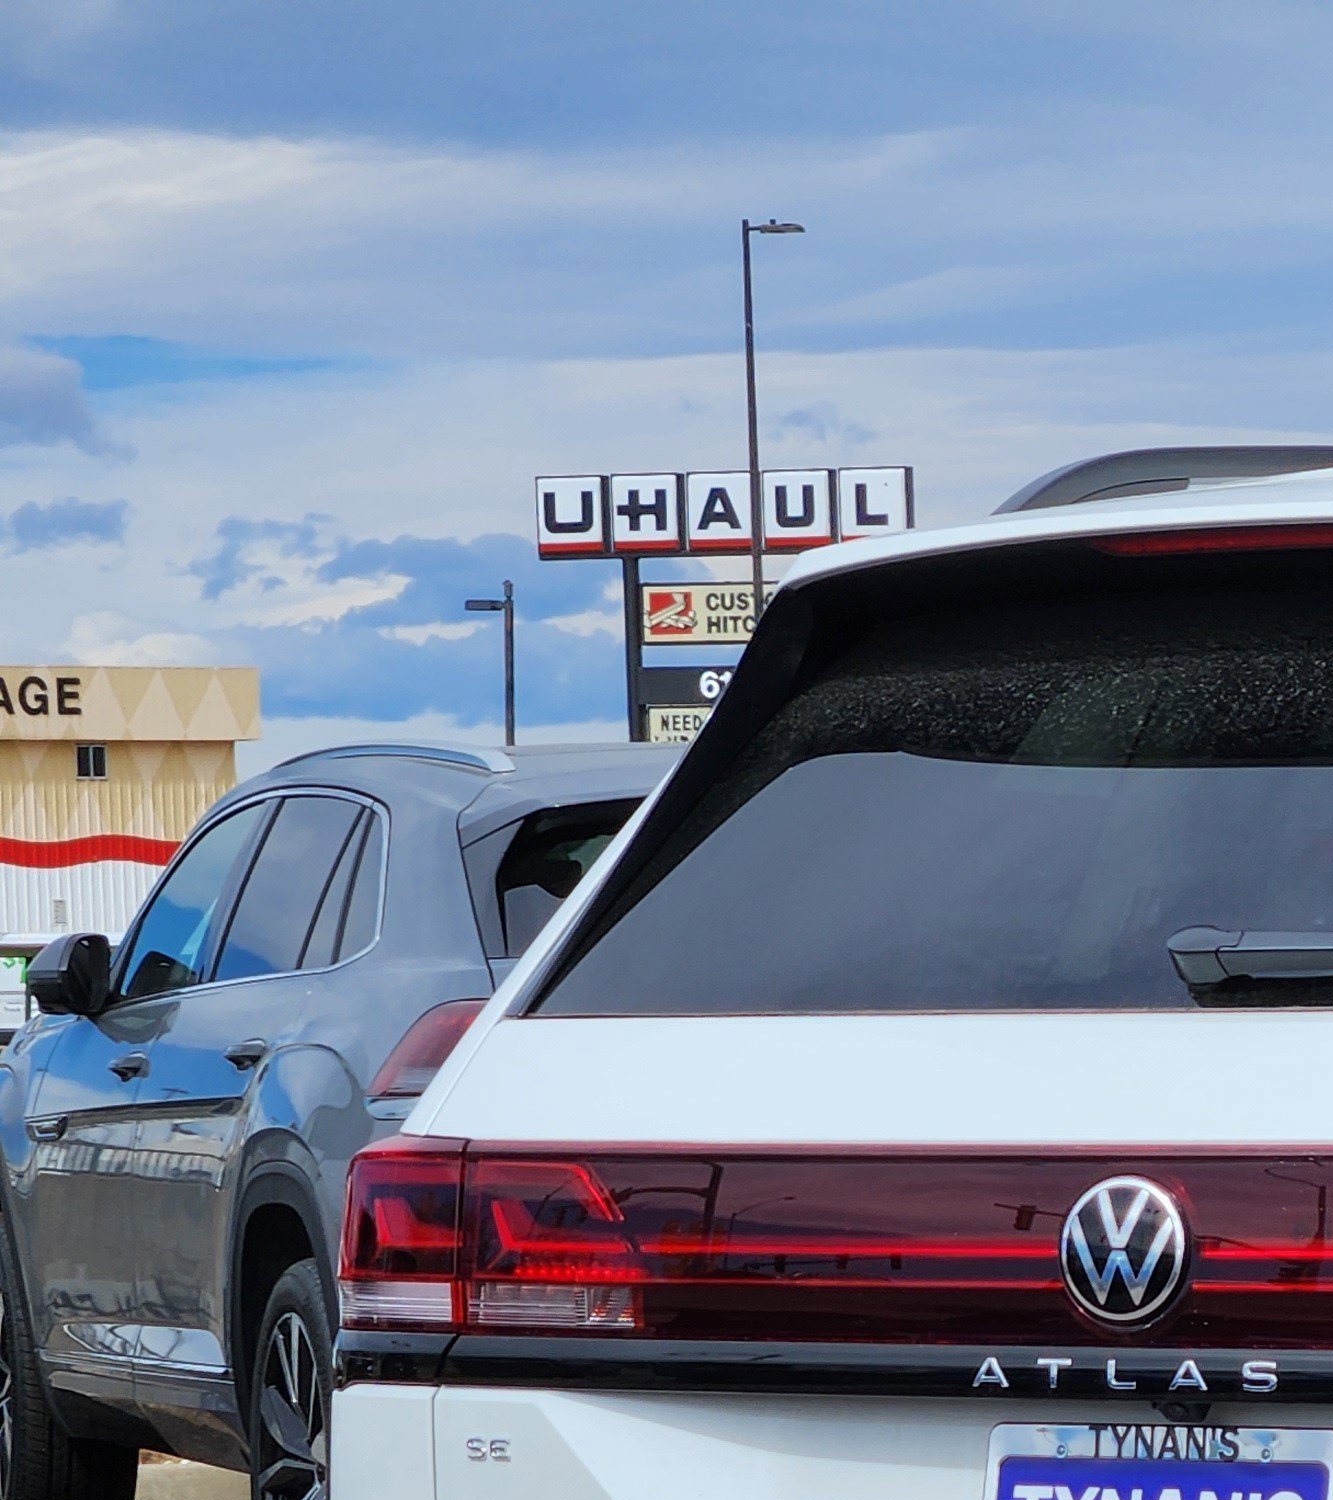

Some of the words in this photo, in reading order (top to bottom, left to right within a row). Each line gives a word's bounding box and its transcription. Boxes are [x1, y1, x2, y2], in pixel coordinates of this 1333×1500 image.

[972, 1356, 1280, 1393] ATLAS
[466, 1438, 511, 1463] SE
[1089, 1425, 1240, 1463] TYNAN'S
